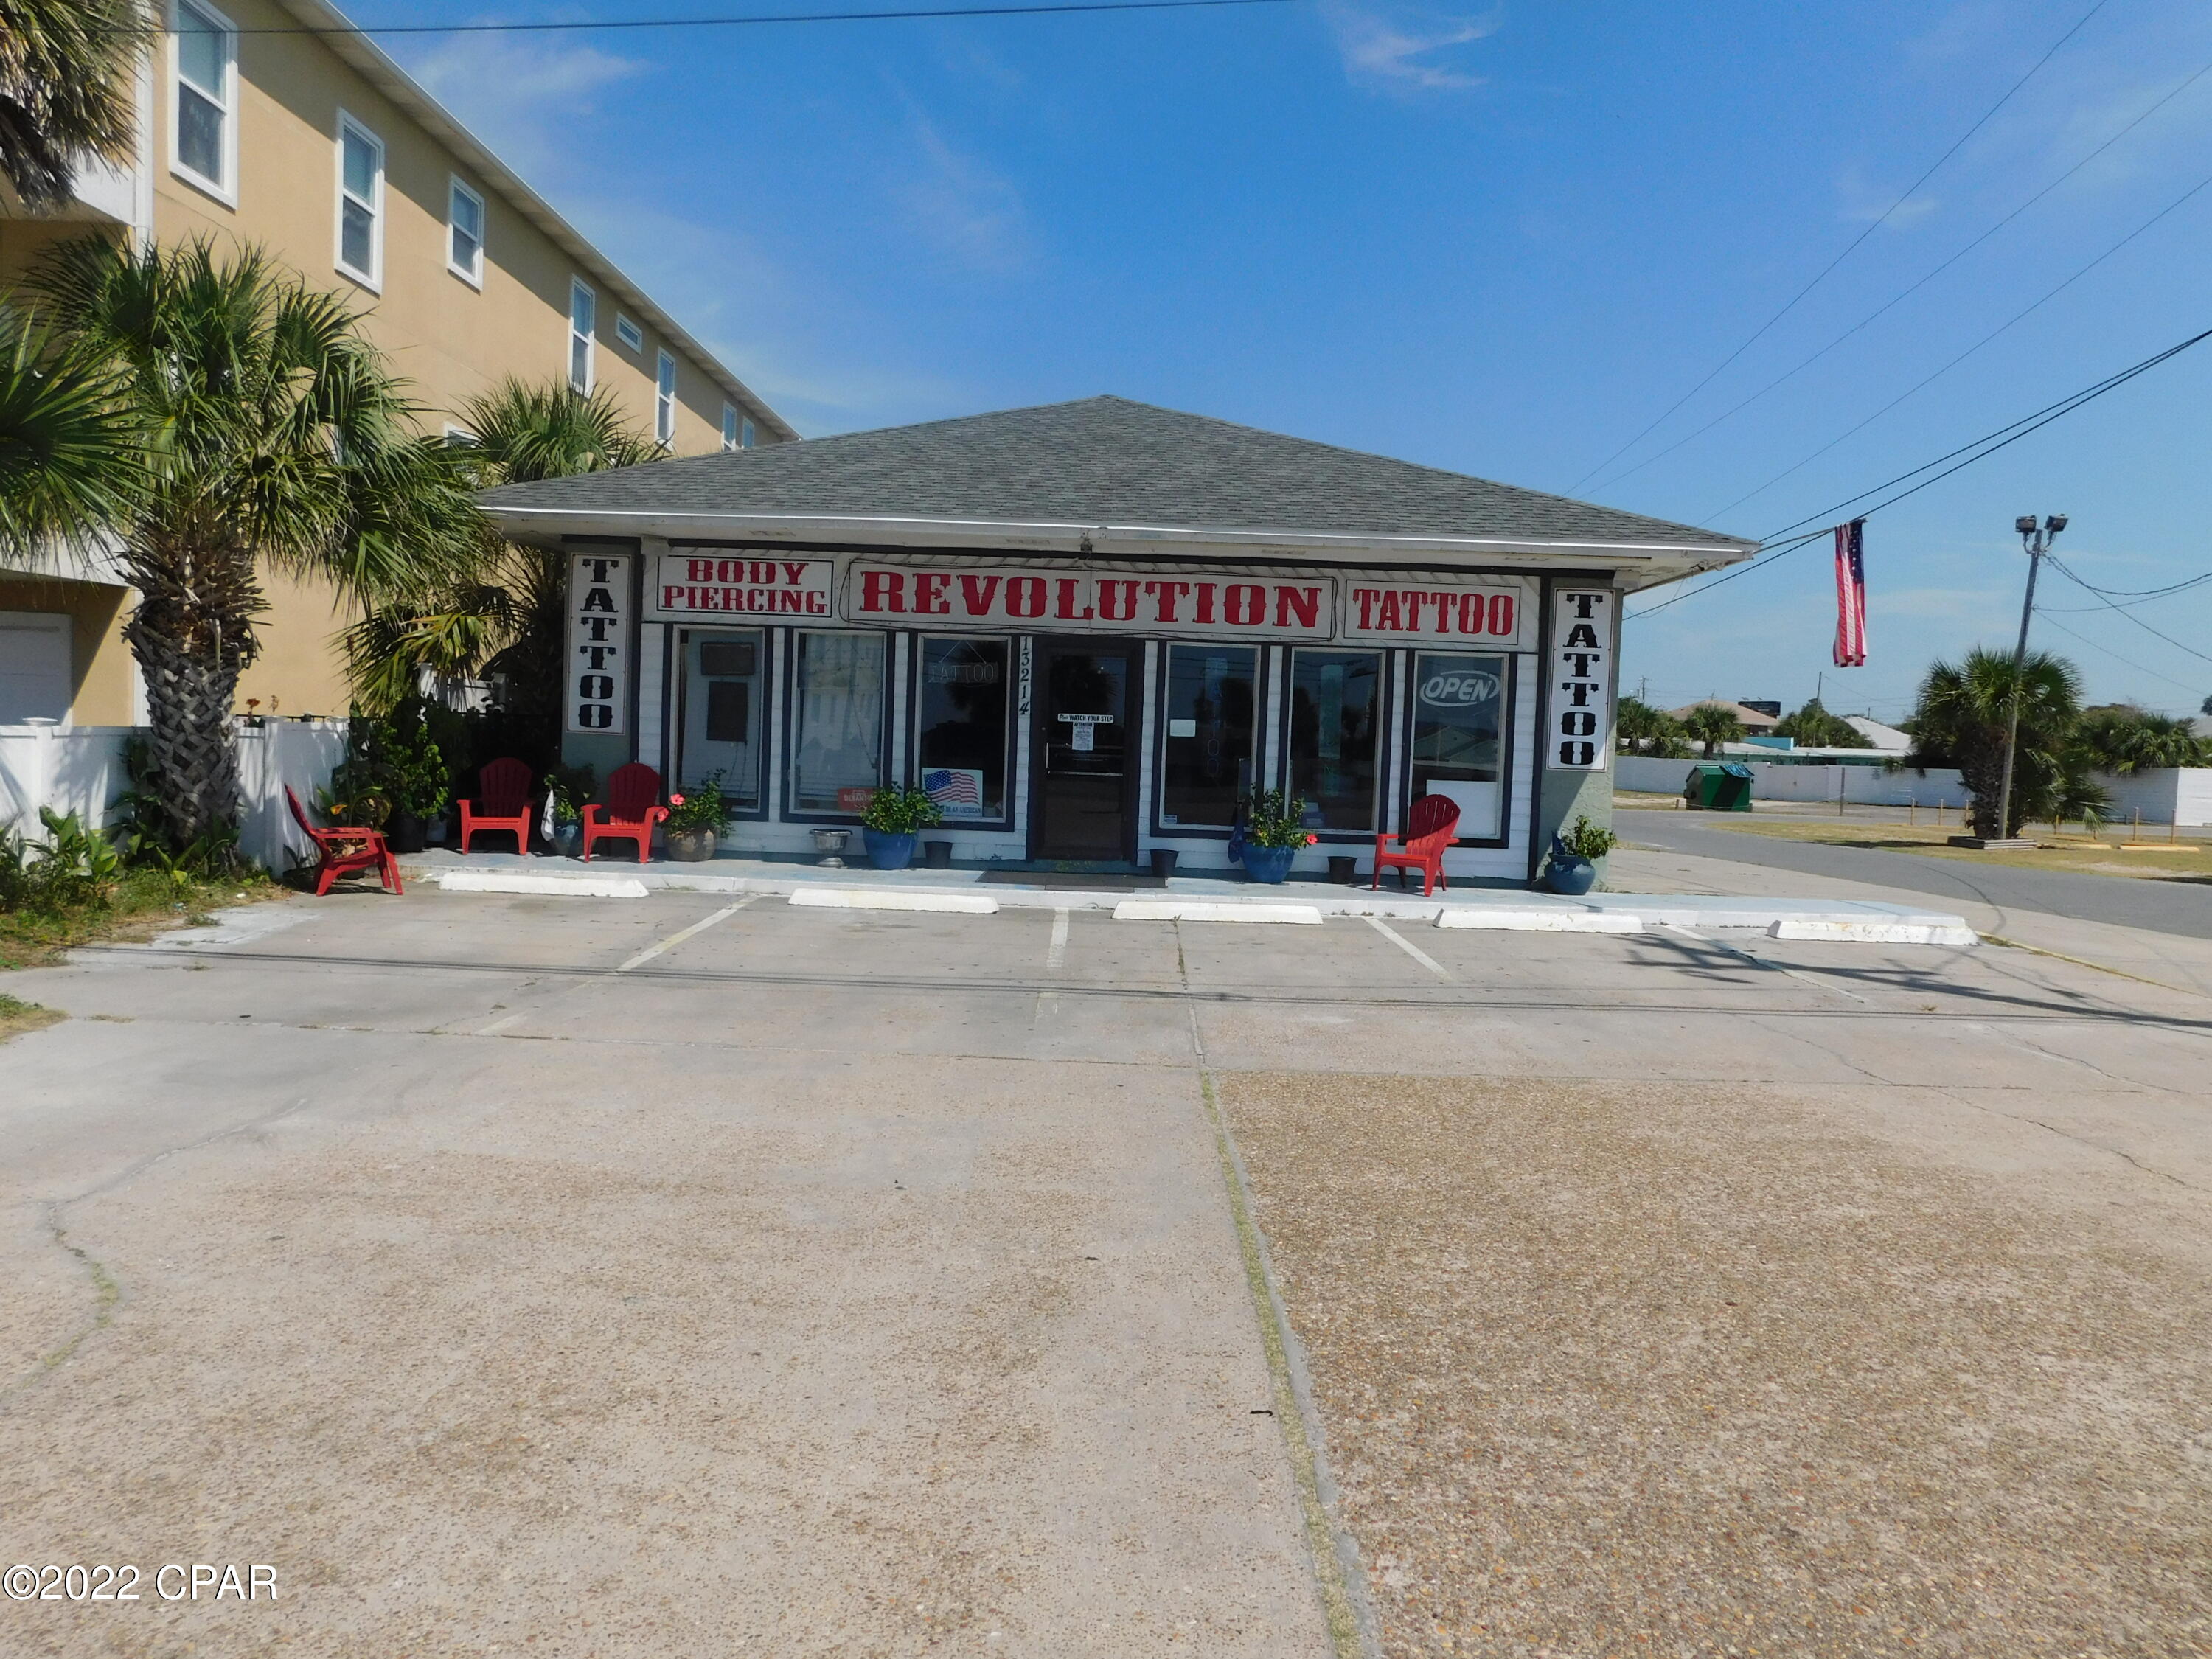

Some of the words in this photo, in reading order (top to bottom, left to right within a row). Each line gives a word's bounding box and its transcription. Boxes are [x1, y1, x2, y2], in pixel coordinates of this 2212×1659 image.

[685, 558, 809, 585] BODY
[662, 585, 827, 614] PIERCING
[858, 571, 1323, 628] REVOLUTION
[1352, 588, 1514, 636] TATTOO
[579, 558, 619, 728] TATTOO
[929, 664, 995, 681] TATTOO
[1425, 676, 1493, 701] OPEN
[1559, 594, 1604, 765] TATTOO
